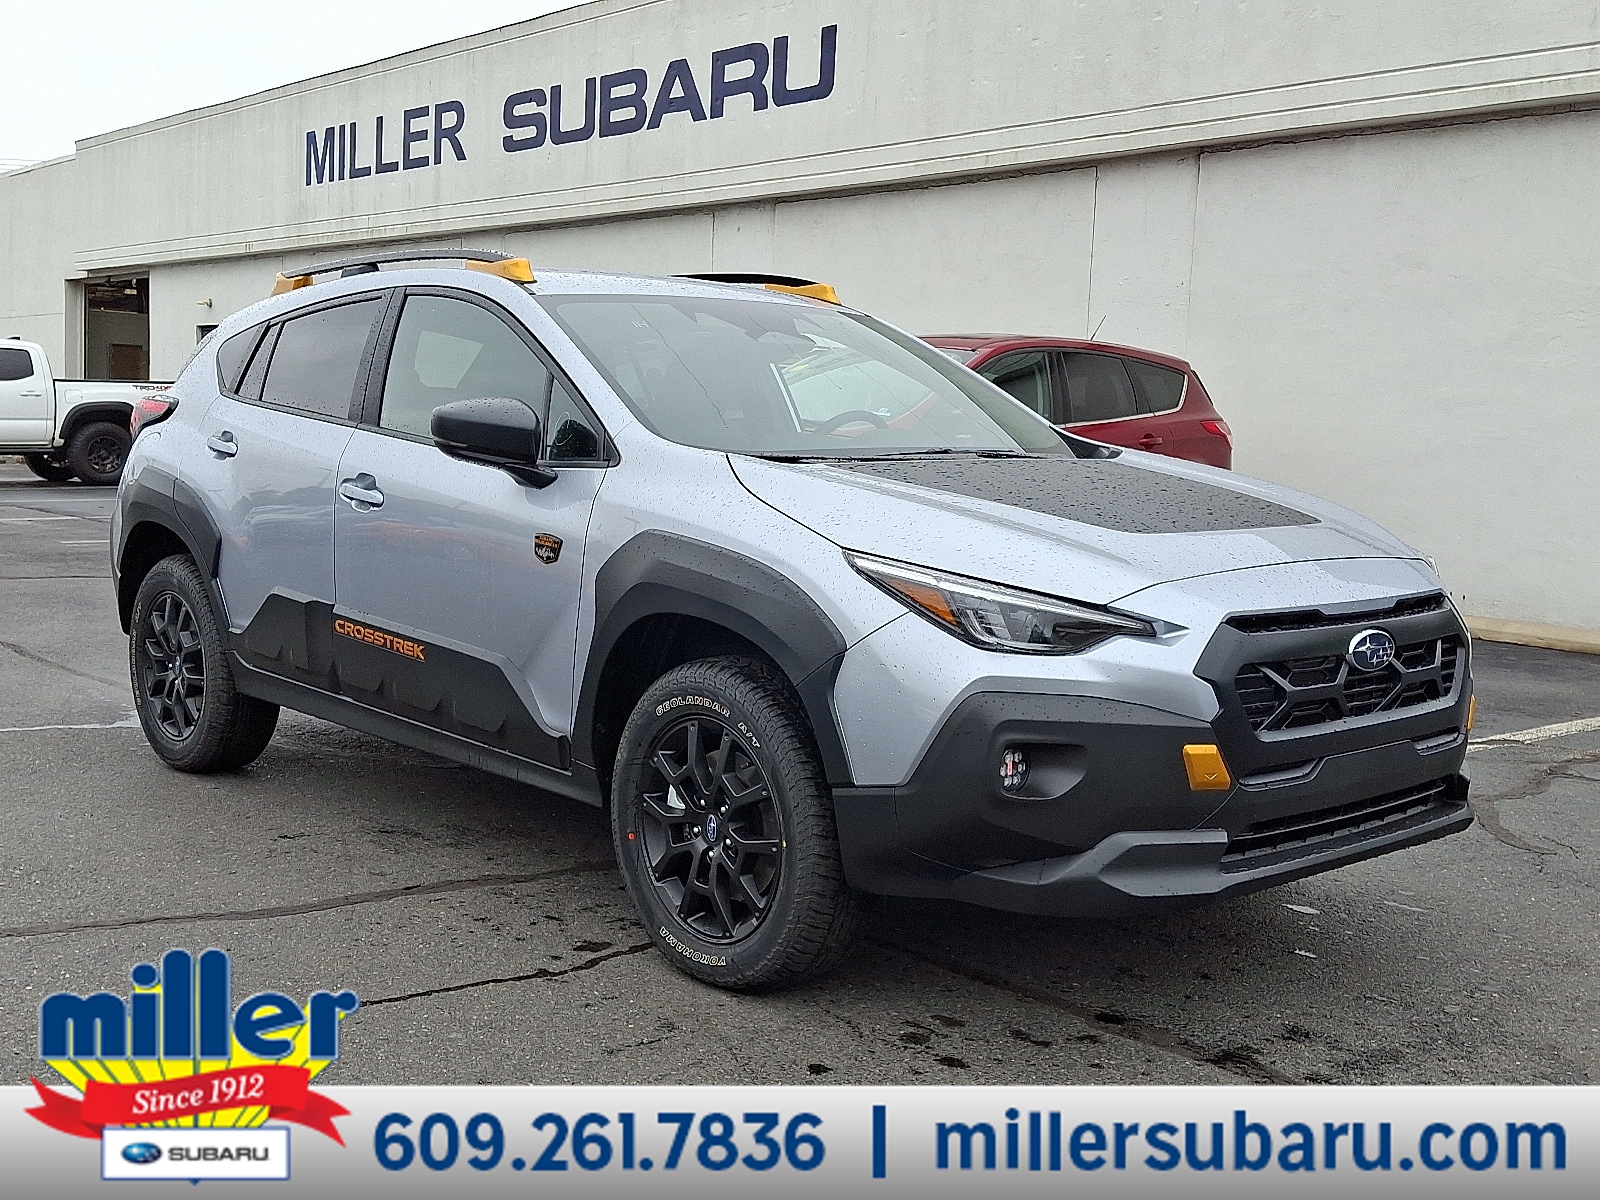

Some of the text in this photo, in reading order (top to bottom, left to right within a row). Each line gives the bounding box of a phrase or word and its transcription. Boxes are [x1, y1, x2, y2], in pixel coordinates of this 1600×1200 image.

[305, 24, 838, 186] MILLER SUBARU
[334, 619, 425, 660] CROSSTREK
[655, 696, 731, 717] GEOLANDAR
[659, 926, 727, 966] YOKOHAMA
